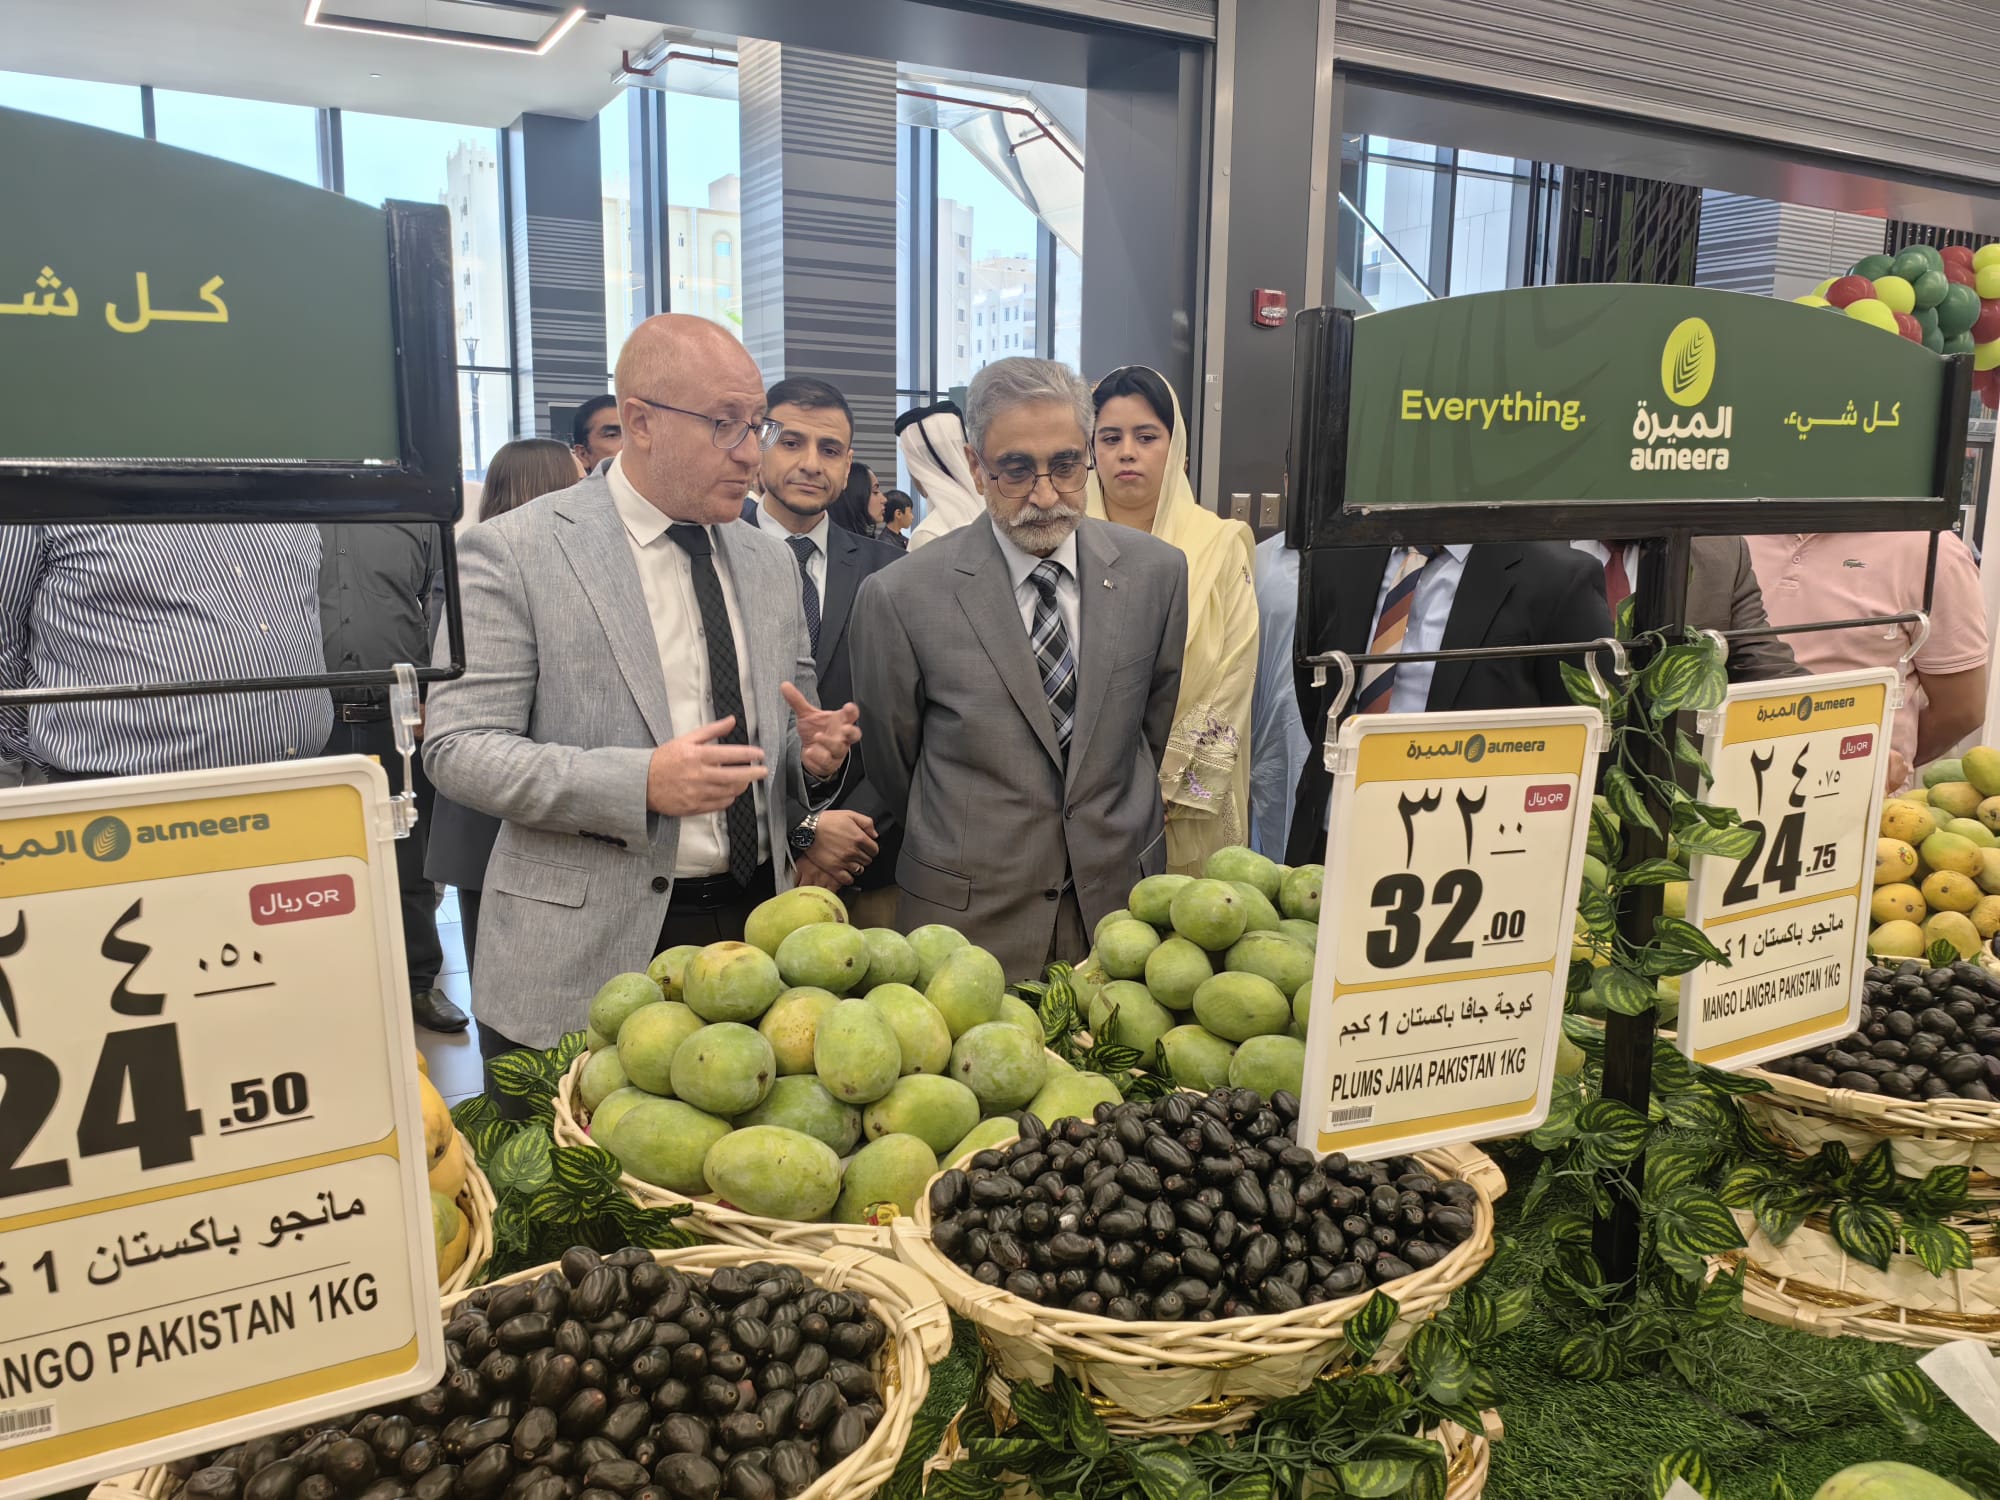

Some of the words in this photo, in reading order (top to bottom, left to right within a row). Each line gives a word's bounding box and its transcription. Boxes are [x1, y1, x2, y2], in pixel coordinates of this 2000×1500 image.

[105, 271, 229, 333] كل
[1400, 389, 1587, 431] Everything.
[1632, 400, 1733, 446] الميرة
[1863, 400, 1900, 433] كل
[1630, 447, 1730, 471] almeera
[1756, 702, 1796, 722] الميرة
[1813, 697, 1855, 712] almeera
[1406, 739, 1463, 761] الميرة
[1487, 739, 1546, 754] almeera
[1856, 741, 1868, 751] QR
[1547, 792, 1564, 804] QR
[137, 812, 271, 845] almeera
[259, 892, 301, 917] ريال
[305, 888, 341, 909] QR
[1753, 922, 1803, 957] باكستان
[1807, 912, 1844, 944] مانجو
[1738, 933, 1747, 959] 1
[1702, 990, 1737, 1022] MANGO
[1740, 978, 1777, 1012] LANGRA
[1778, 969, 1821, 1000] PAKISTAN
[1823, 963, 1841, 989] 1KG
[1338, 1014, 1372, 1047] كجم
[1378, 1010, 1389, 1036] 1
[1396, 1003, 1455, 1036] باكستان
[1331, 1066, 1383, 1102] PLUMS
[1385, 1062, 1424, 1094] JAVA
[1427, 1051, 1496, 1087] PAKISTAN
[1499, 1047, 1527, 1075] 1KG
[258, 1190, 366, 1248] مانجو
[87, 1216, 241, 1285] باكستان
[32, 1250, 59, 1294] 1
[0, 1341, 95, 1399] NGO
[107, 1290, 297, 1375] PAKISTAN
[308, 1272, 380, 1323] 1KG
